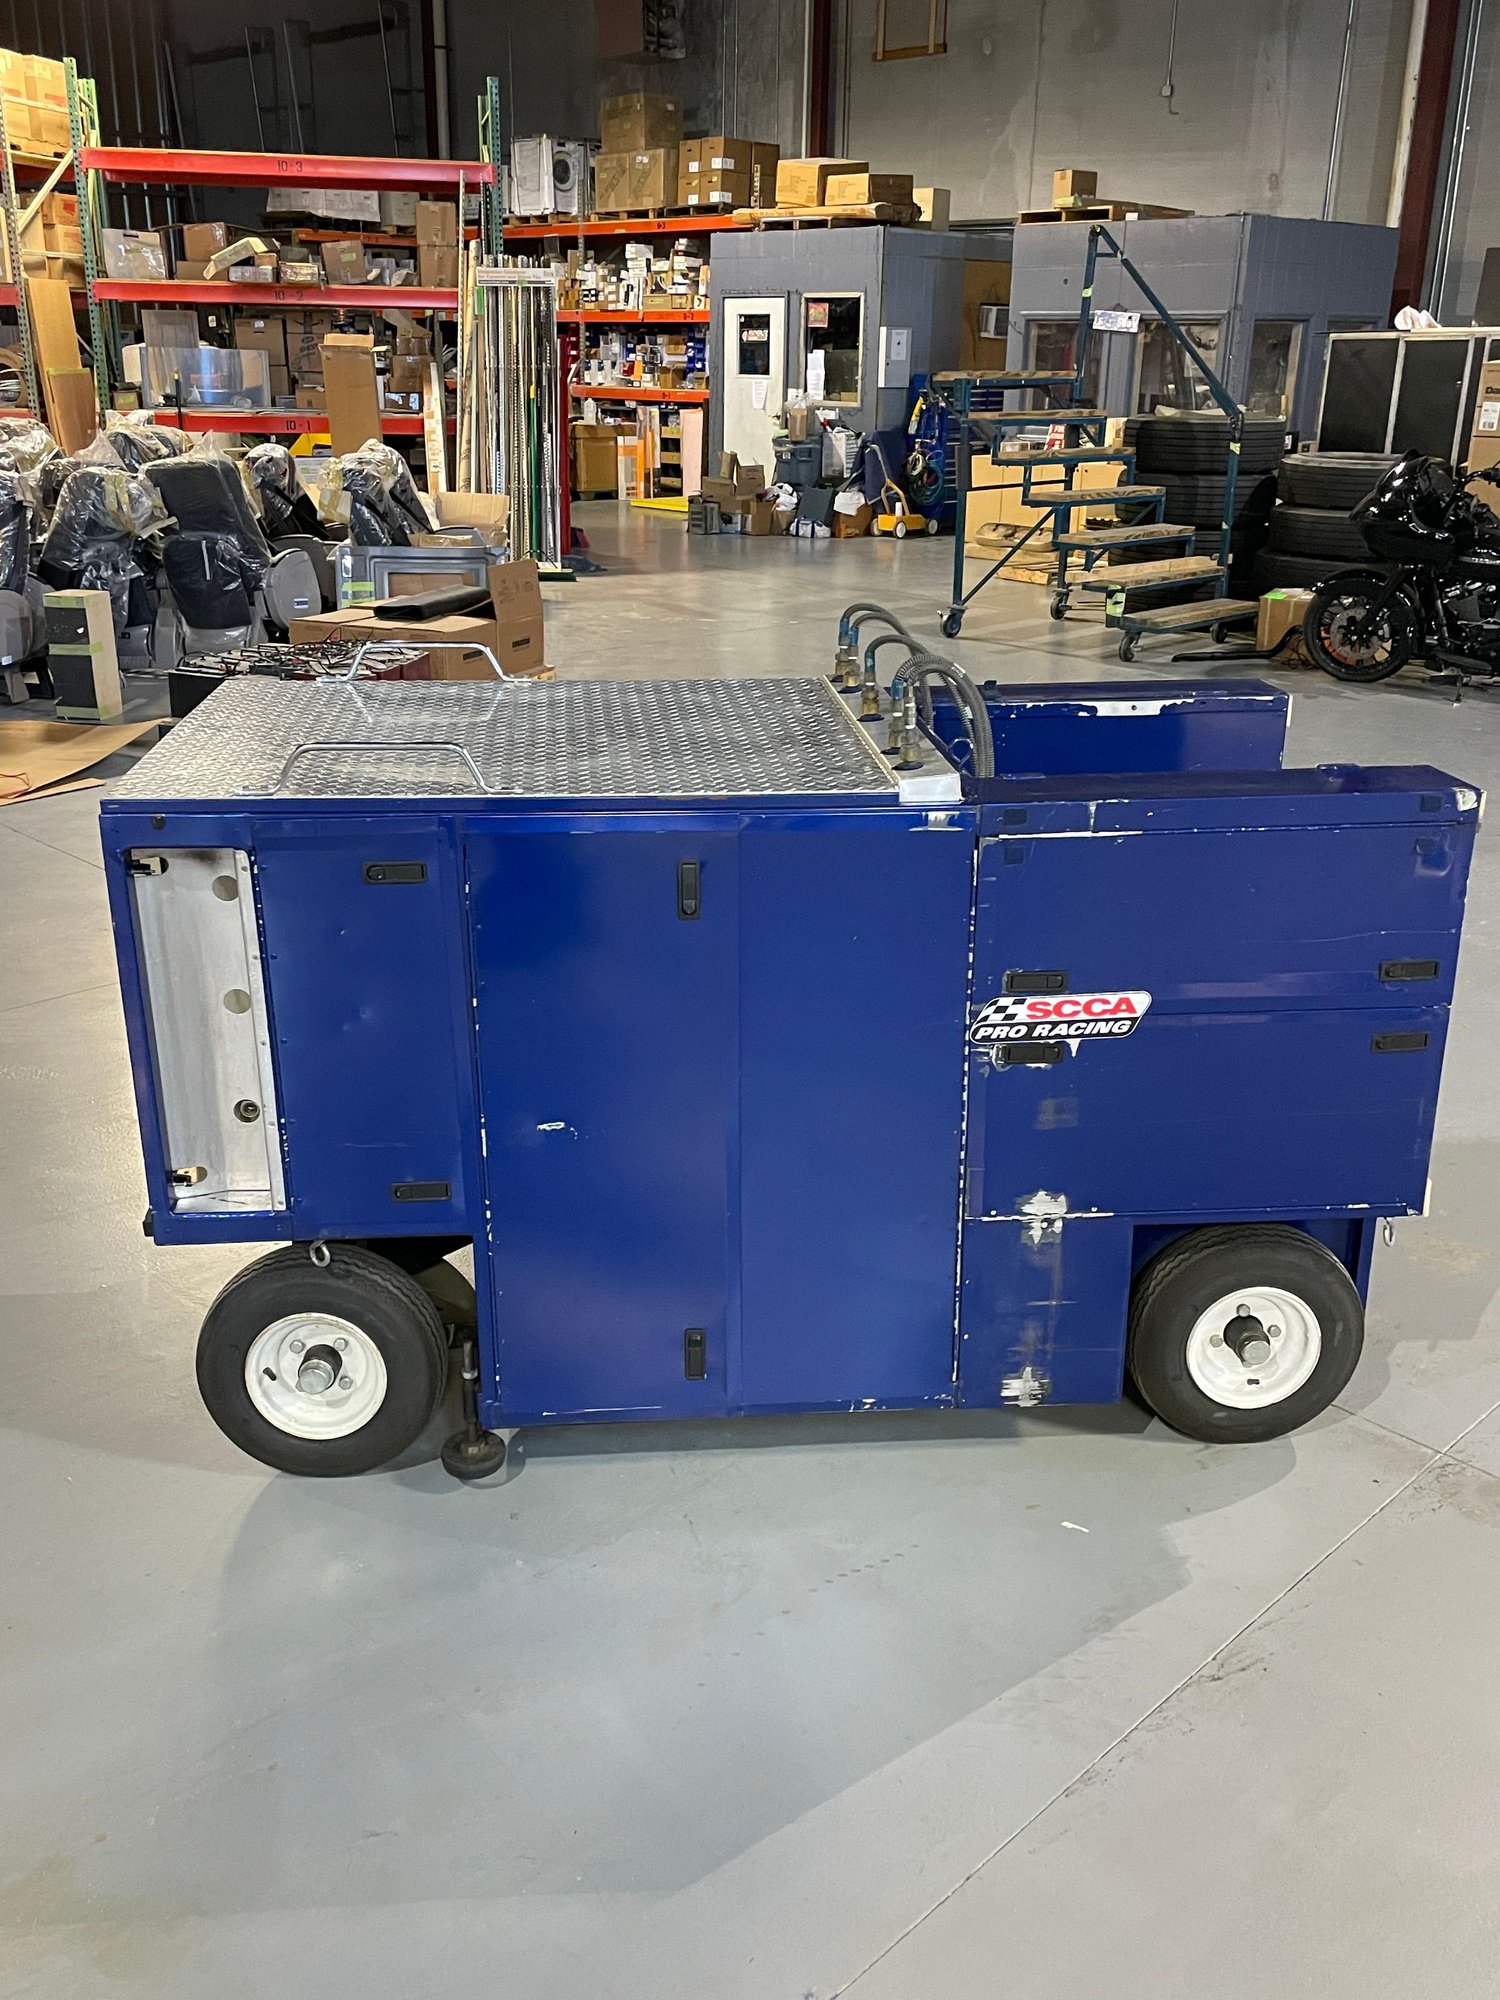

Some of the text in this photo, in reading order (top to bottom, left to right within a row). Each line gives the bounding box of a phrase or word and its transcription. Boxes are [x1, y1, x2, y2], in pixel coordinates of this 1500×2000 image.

[1026, 997, 1137, 1020] SCCA
[975, 1020, 1133, 1040] PRO RACING
